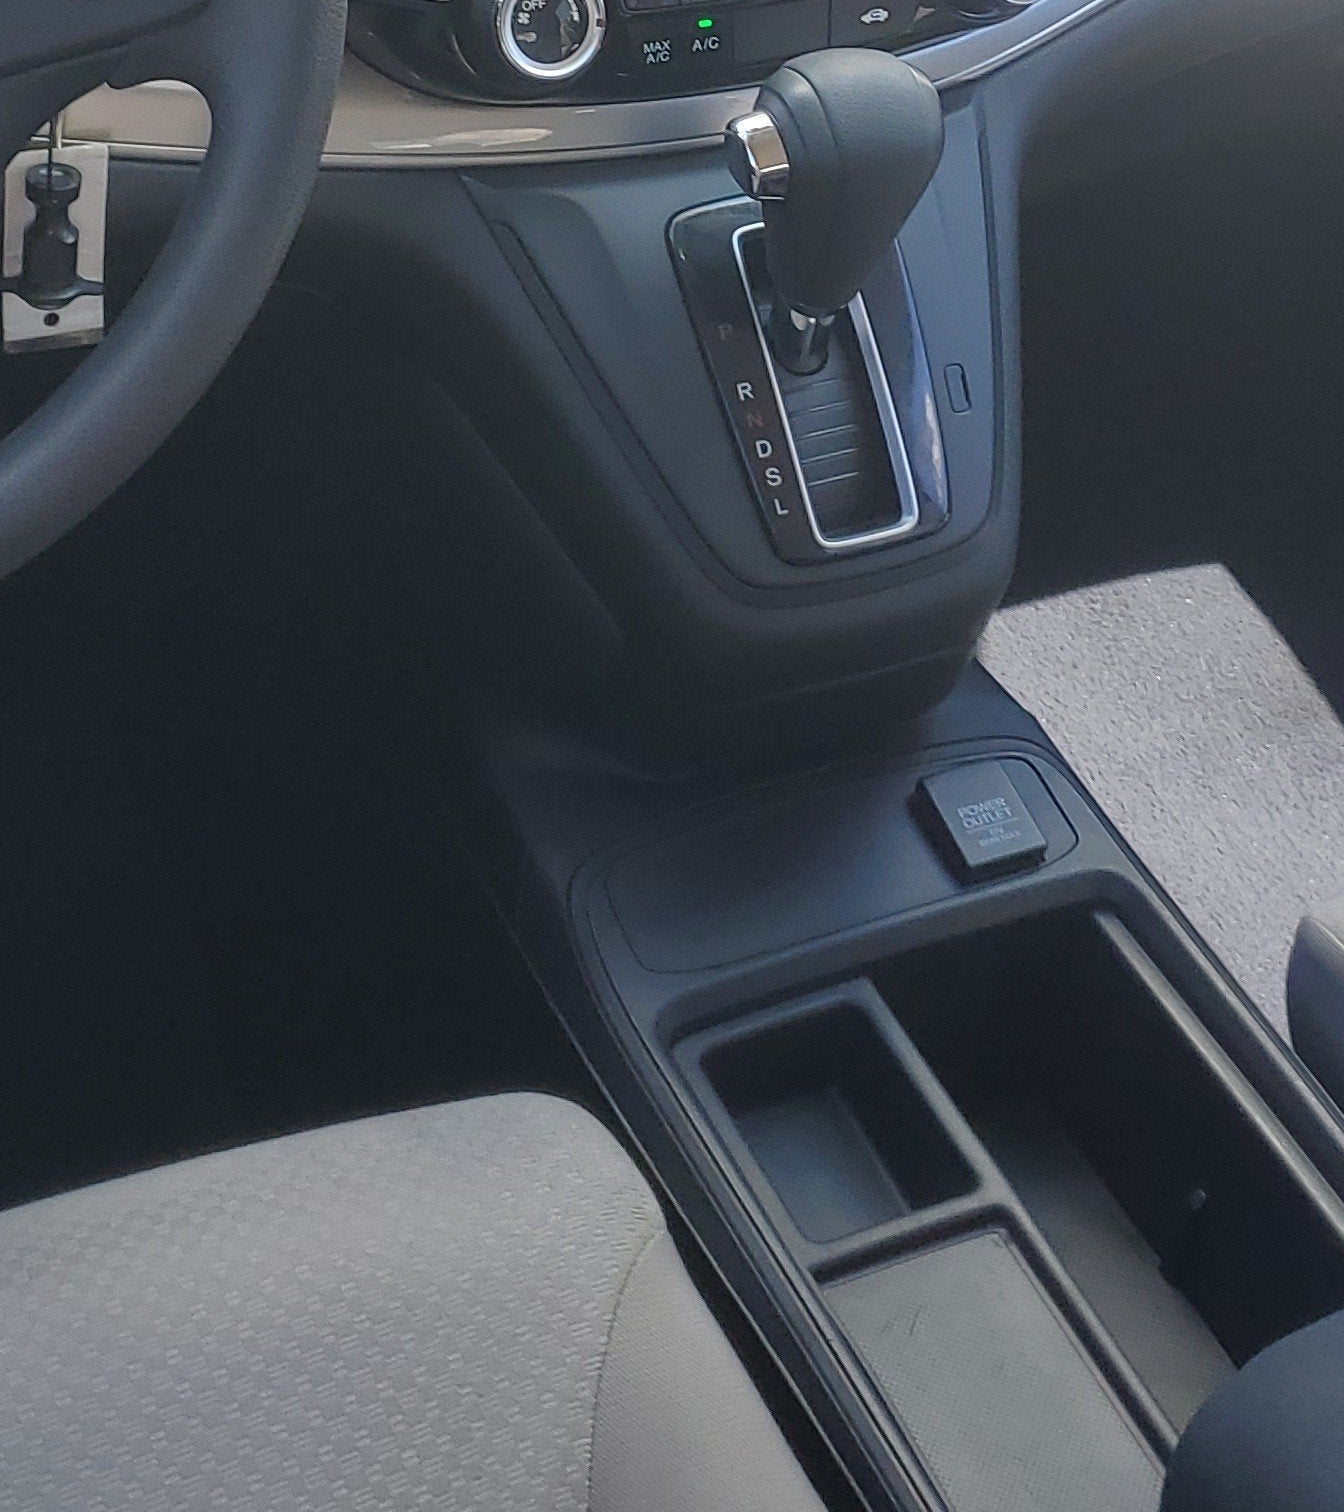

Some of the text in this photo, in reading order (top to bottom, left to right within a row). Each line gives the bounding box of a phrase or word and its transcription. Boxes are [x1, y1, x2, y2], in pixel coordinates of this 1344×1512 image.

[643, 38, 672, 54] MAX
[691, 35, 721, 53] A/C
[645, 50, 671, 65] A/C
[736, 381, 755, 402] R
[756, 439, 773, 459] D
[765, 466, 783, 487] S
[773, 498, 790, 516] L
[957, 797, 1007, 818] POWER
[962, 806, 1012, 829] OUTLET
